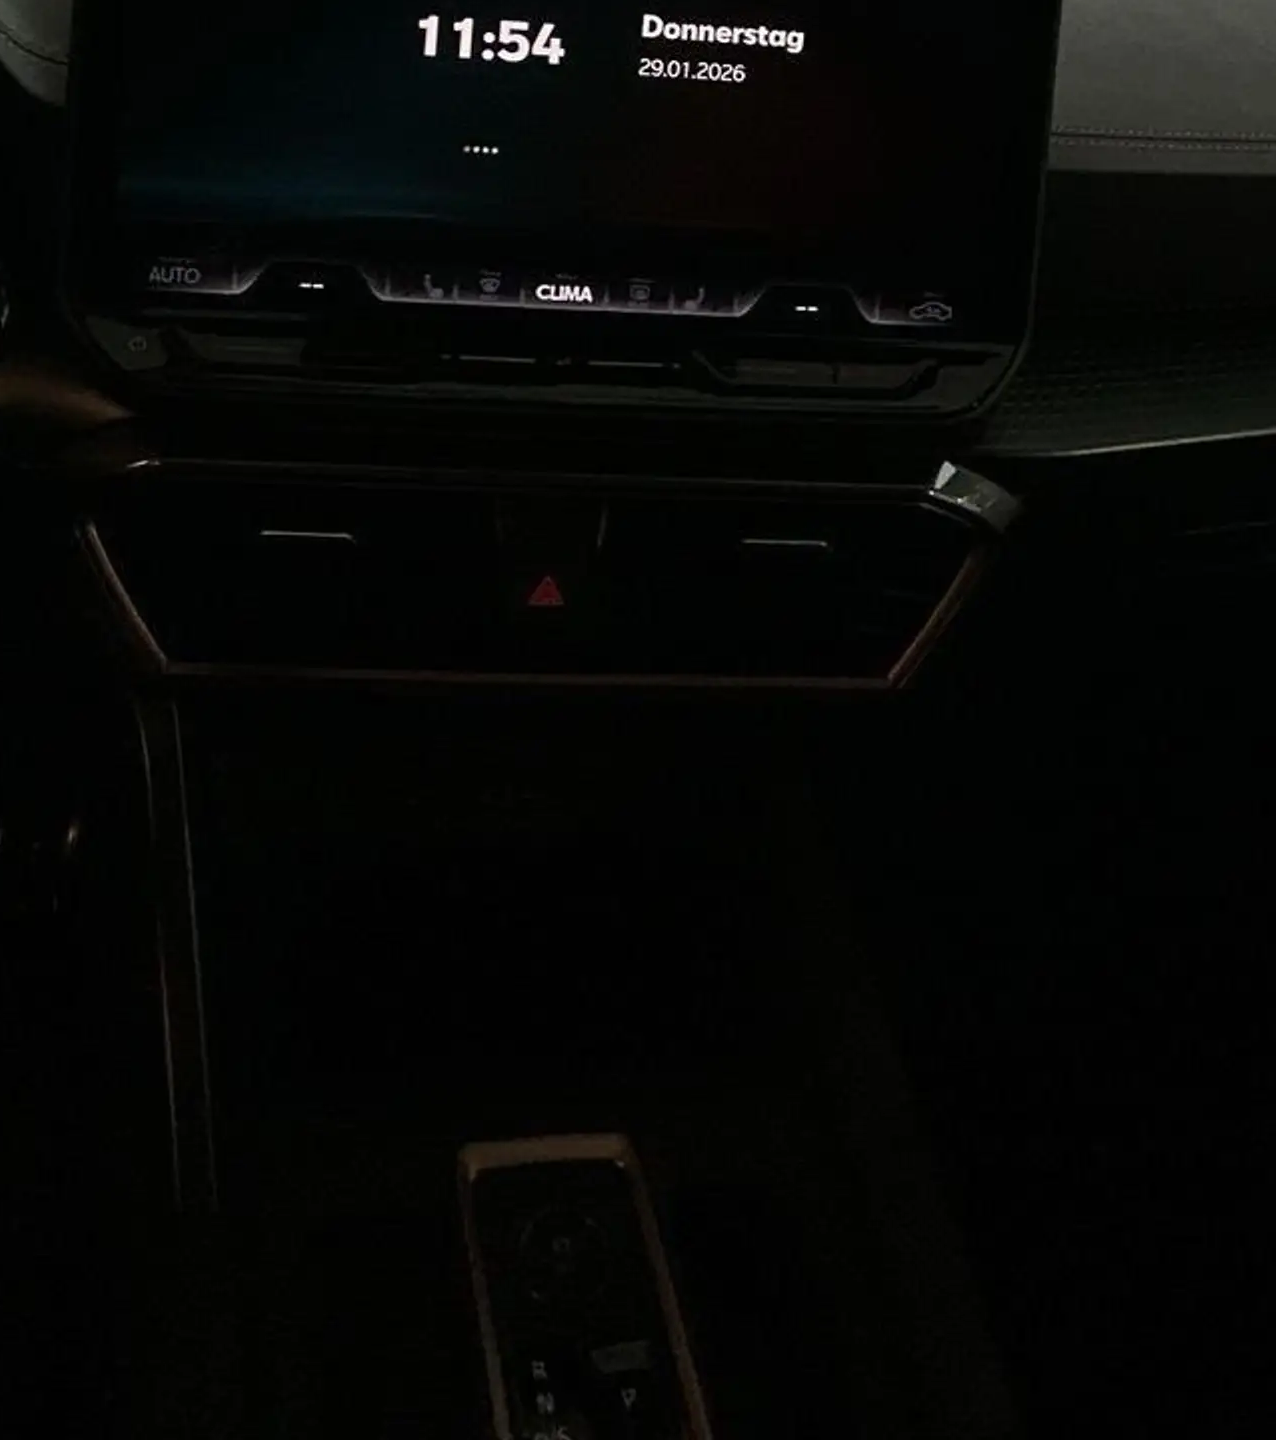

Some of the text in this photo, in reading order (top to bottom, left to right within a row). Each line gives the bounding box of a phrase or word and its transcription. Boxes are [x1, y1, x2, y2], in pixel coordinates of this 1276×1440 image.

[418, 14, 566, 66] 11:54
[640, 13, 805, 54] Donnerstag
[637, 57, 747, 84] 29.01.2026
[148, 265, 202, 284] AUTO
[536, 283, 595, 305] CLIMA
